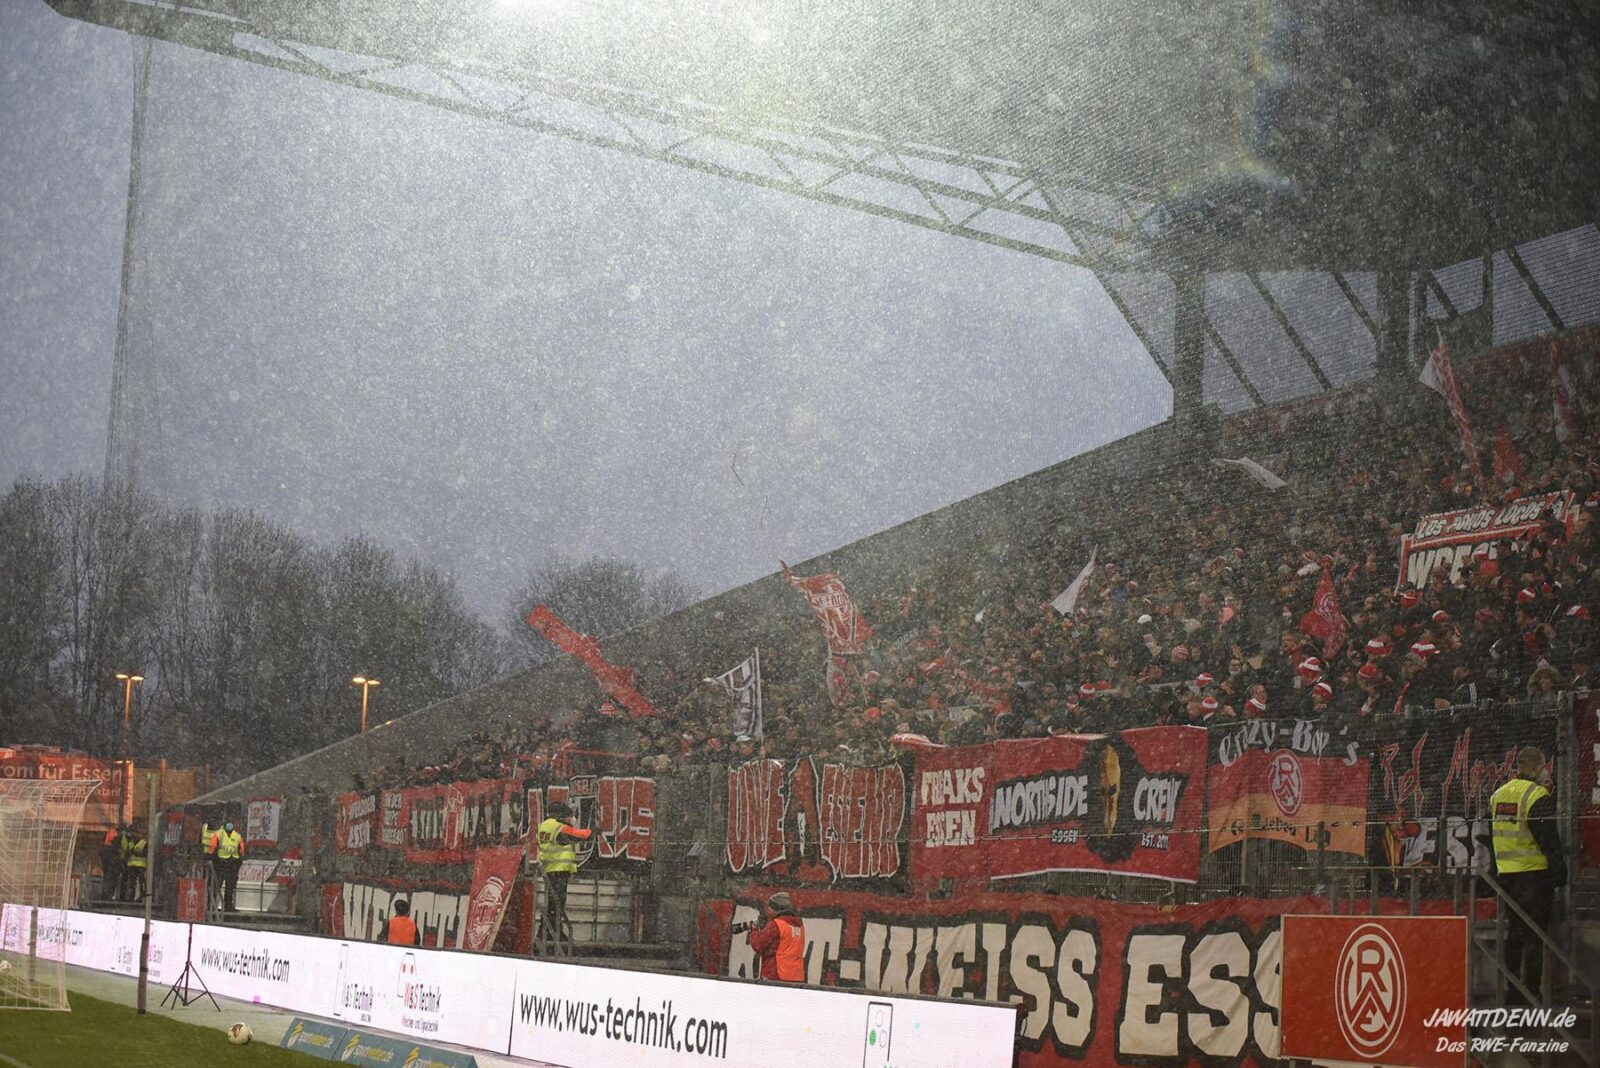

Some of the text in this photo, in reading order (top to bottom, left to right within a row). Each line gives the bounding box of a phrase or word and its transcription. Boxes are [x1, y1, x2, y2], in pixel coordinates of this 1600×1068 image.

[39, 763, 66, 780] für
[72, 764, 122, 781] Essen
[921, 767, 985, 806] FREAKS
[989, 774, 1183, 834] NORTHSIDE CREW
[925, 809, 976, 849] ESSEN
[201, 951, 290, 982] www.wus-technik.com
[728, 905, 1097, 1048] RT-WEISS
[520, 993, 728, 1059] www.wus-technik.com
